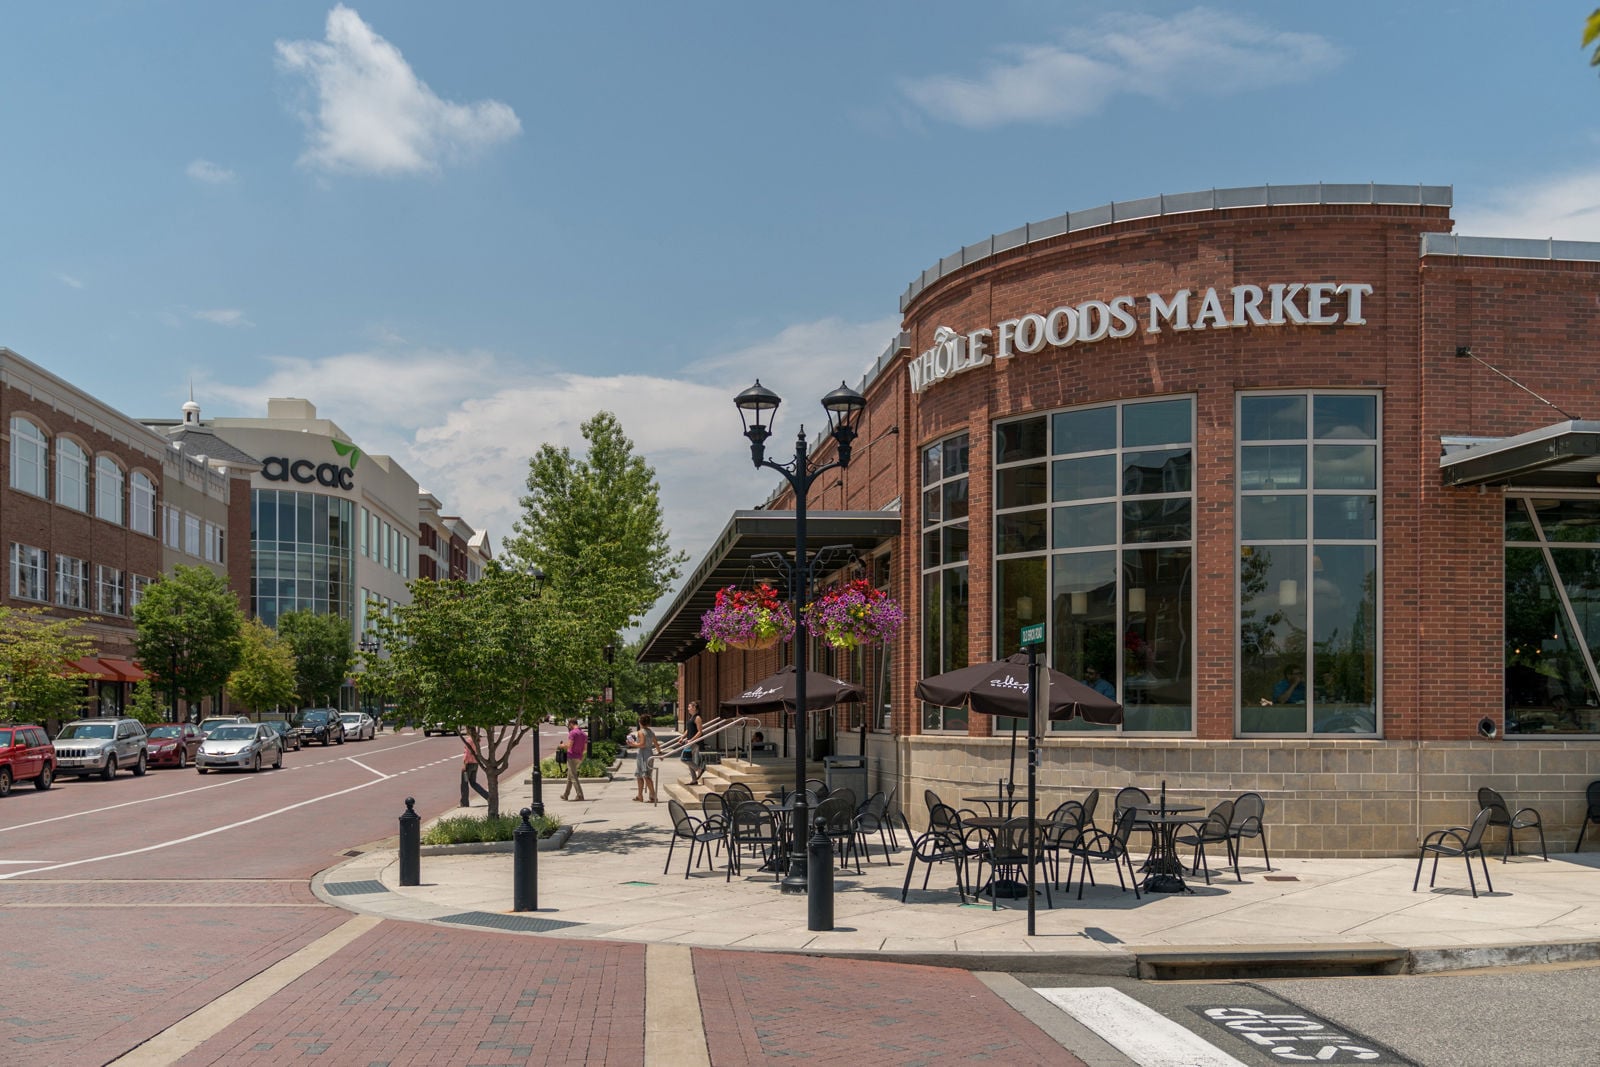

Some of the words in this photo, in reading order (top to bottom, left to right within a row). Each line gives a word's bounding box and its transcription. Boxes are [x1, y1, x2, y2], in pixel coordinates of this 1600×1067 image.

[908, 326, 993, 394] WHOLE
[996, 295, 1137, 359] FOODS
[1146, 282, 1374, 333] MARKET
[260, 456, 354, 491] acac
[1203, 1007, 1380, 1060] STOP
